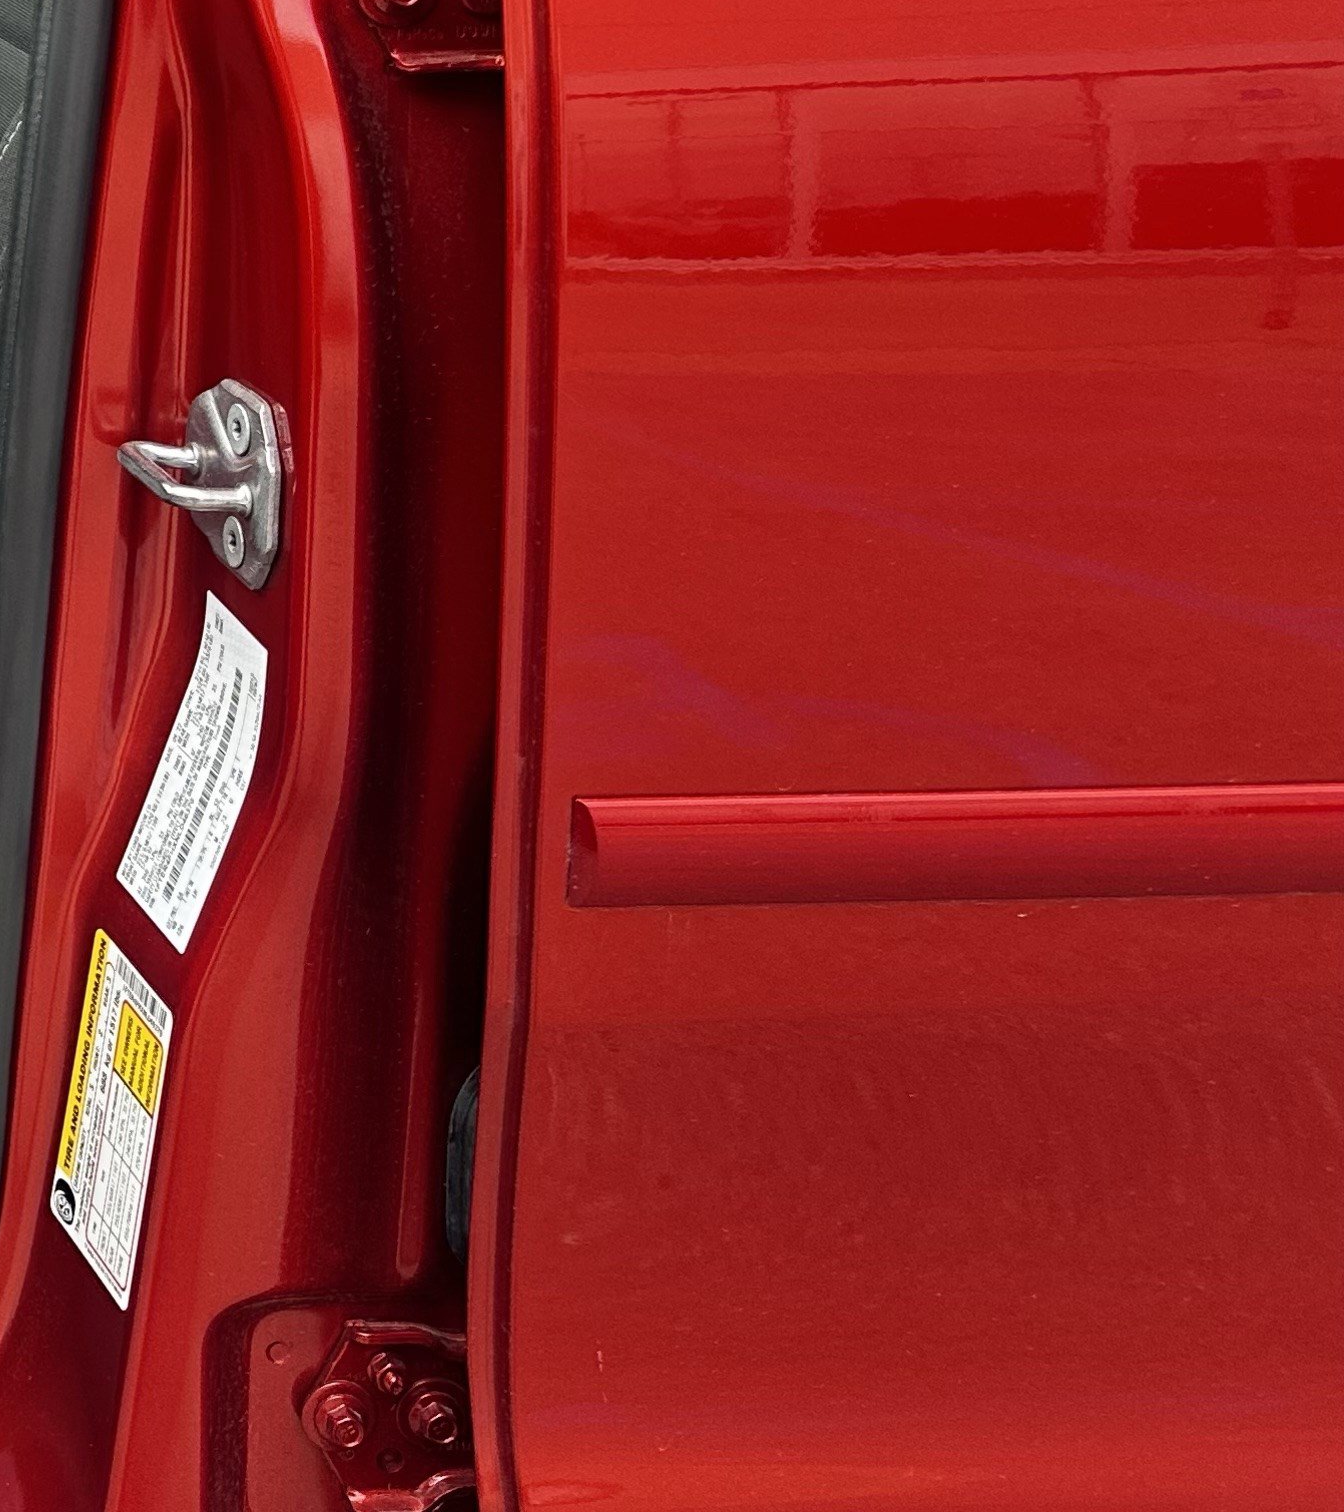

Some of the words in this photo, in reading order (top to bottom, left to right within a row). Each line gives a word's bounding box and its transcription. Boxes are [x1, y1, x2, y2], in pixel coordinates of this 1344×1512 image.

[64, 1139, 74, 1170] TIRE
[70, 1106, 79, 1134] AND
[79, 1040, 90, 1104] LOADING
[87, 938, 106, 1038] INFORMATION
